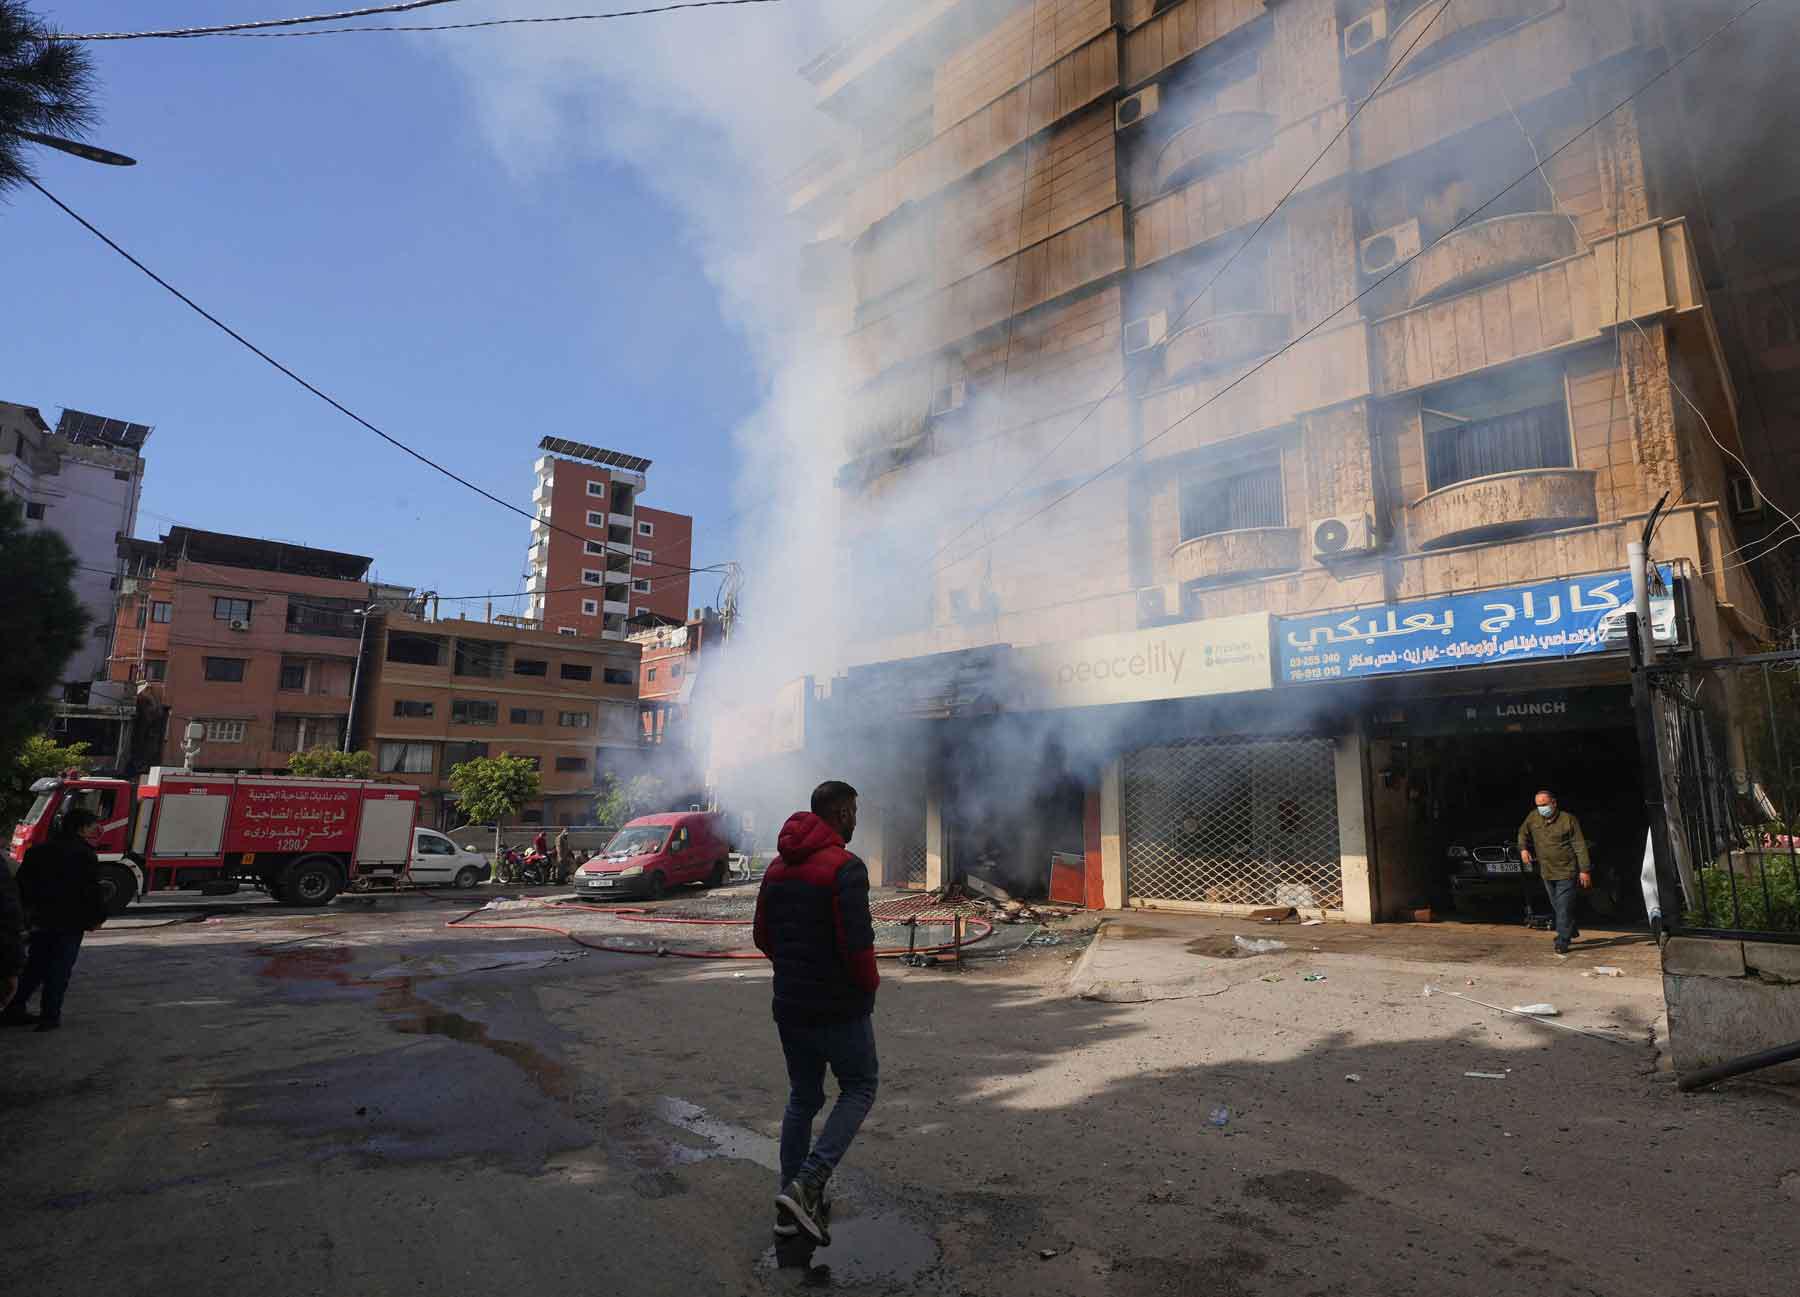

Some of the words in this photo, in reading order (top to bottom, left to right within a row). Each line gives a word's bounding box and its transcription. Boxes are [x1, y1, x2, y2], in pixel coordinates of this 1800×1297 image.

[1480, 579, 1620, 632] كاراج
[1287, 609, 1454, 652] بعلبكي
[1056, 640, 1187, 687] peacelily
[1496, 701, 1567, 717] LAUNCH
[245, 806, 293, 822] الضاحية
[323, 808, 345, 824] فوج
[305, 826, 343, 840] مركز
